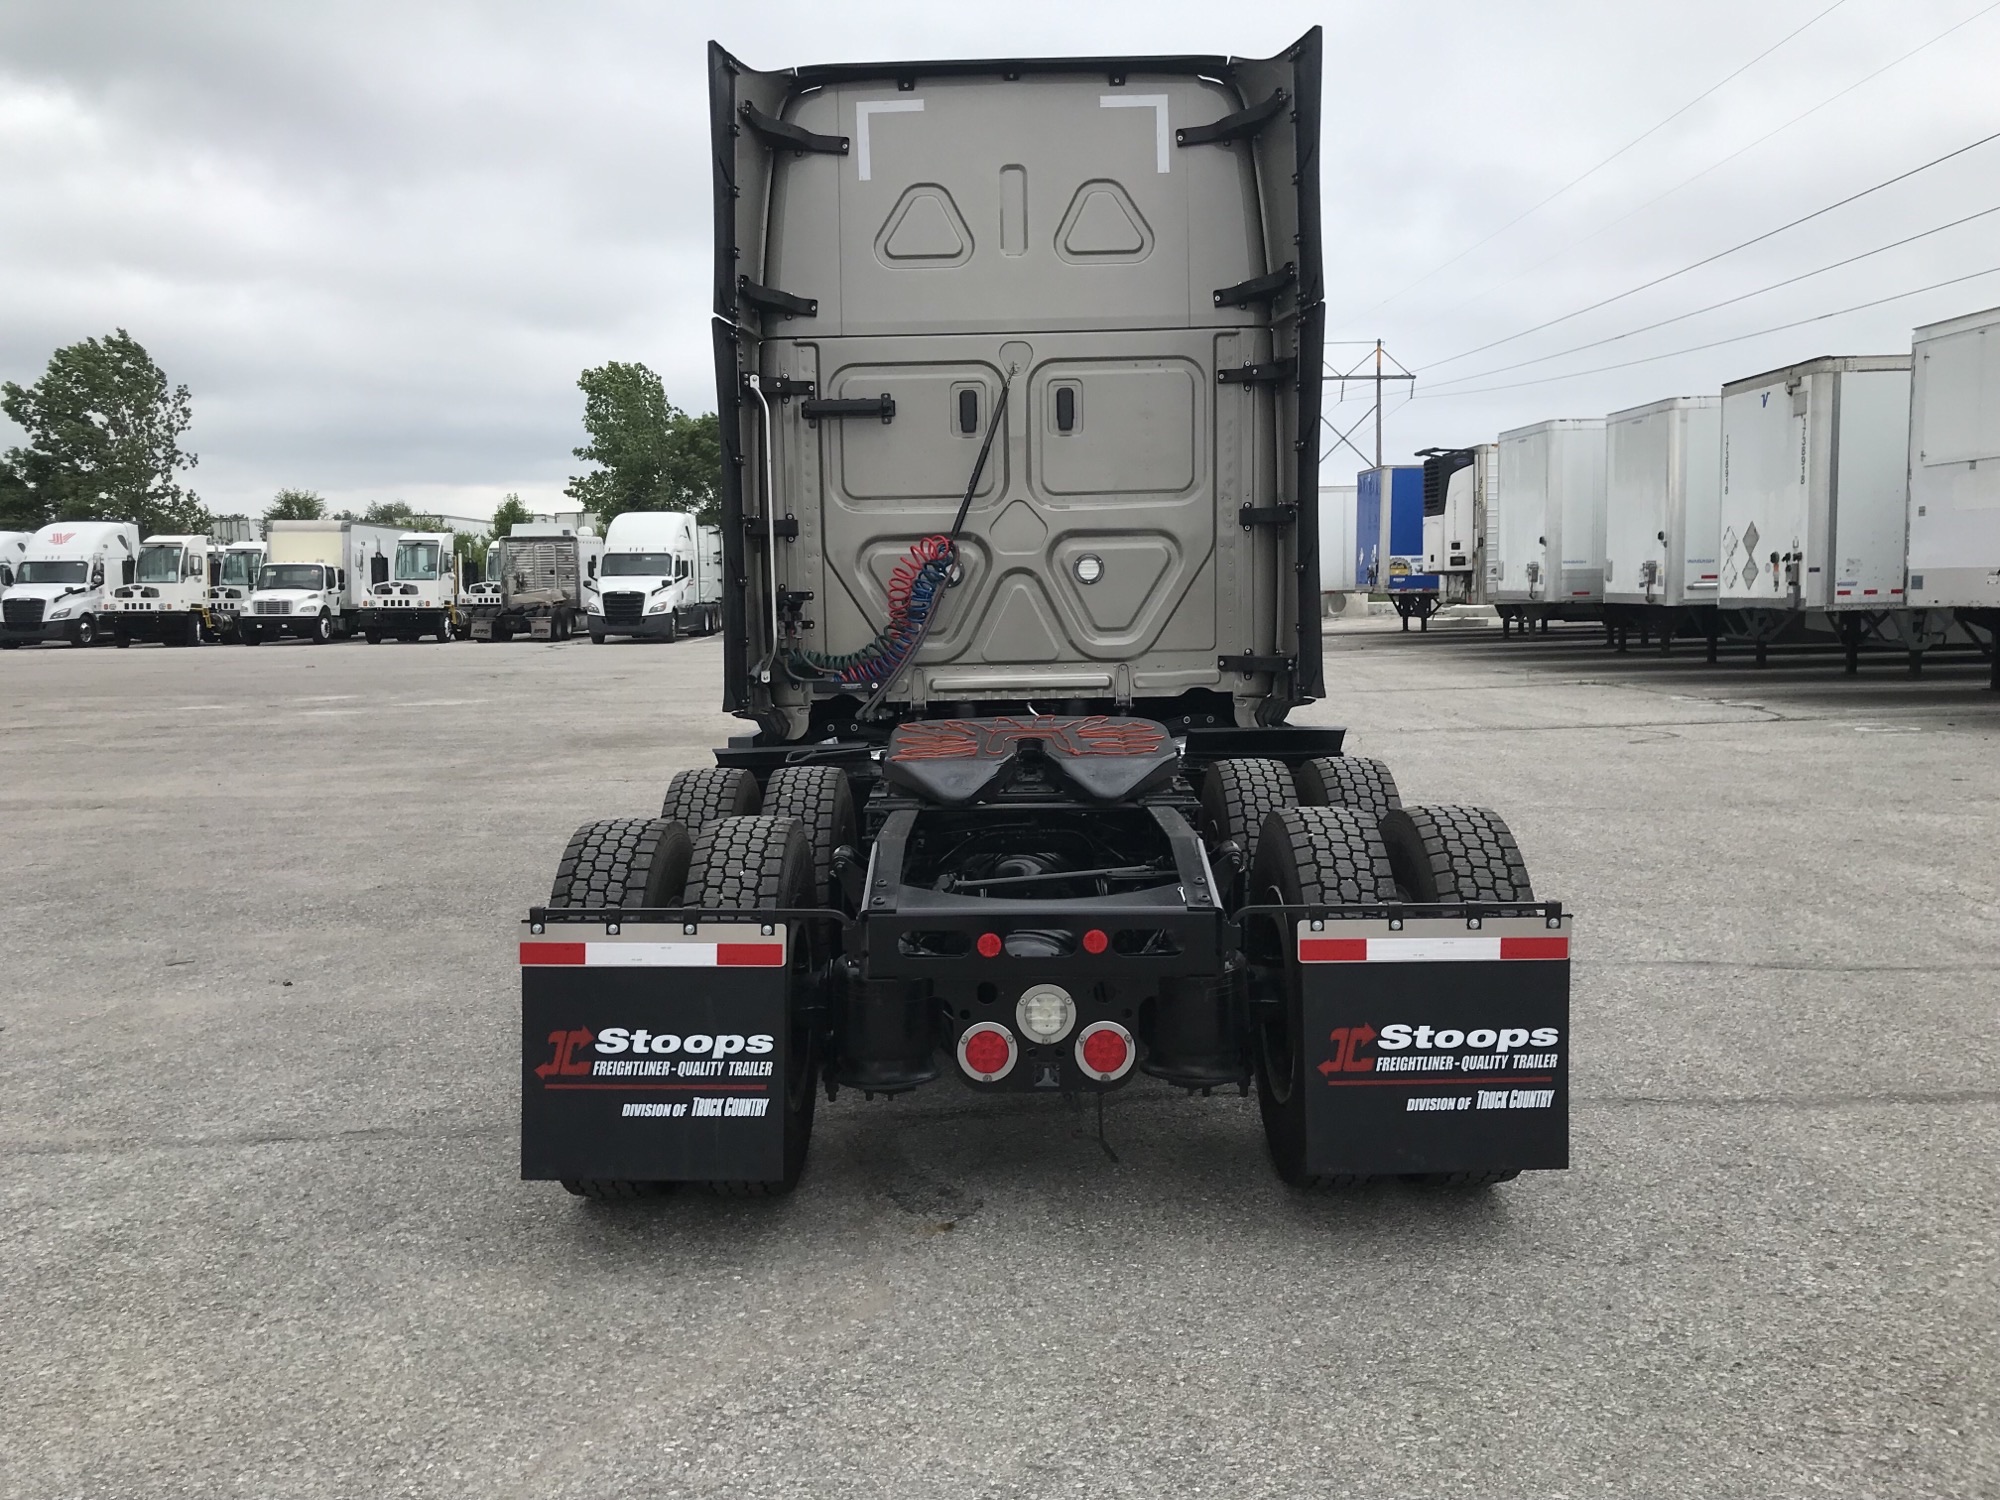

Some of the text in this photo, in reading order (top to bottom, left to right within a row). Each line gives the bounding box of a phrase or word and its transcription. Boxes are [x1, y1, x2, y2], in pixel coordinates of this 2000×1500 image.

[594, 1027, 774, 1060] Stoops
[1377, 1023, 1559, 1053] Stoops
[728, 1061, 774, 1077] TRAILER
[1512, 1053, 1559, 1069] TRAILER
[621, 1096, 770, 1117] DIVISION OF TRUCK COUNTRY
[1406, 1089, 1556, 1112] DIVISION OF TRUCK COUNTRY
